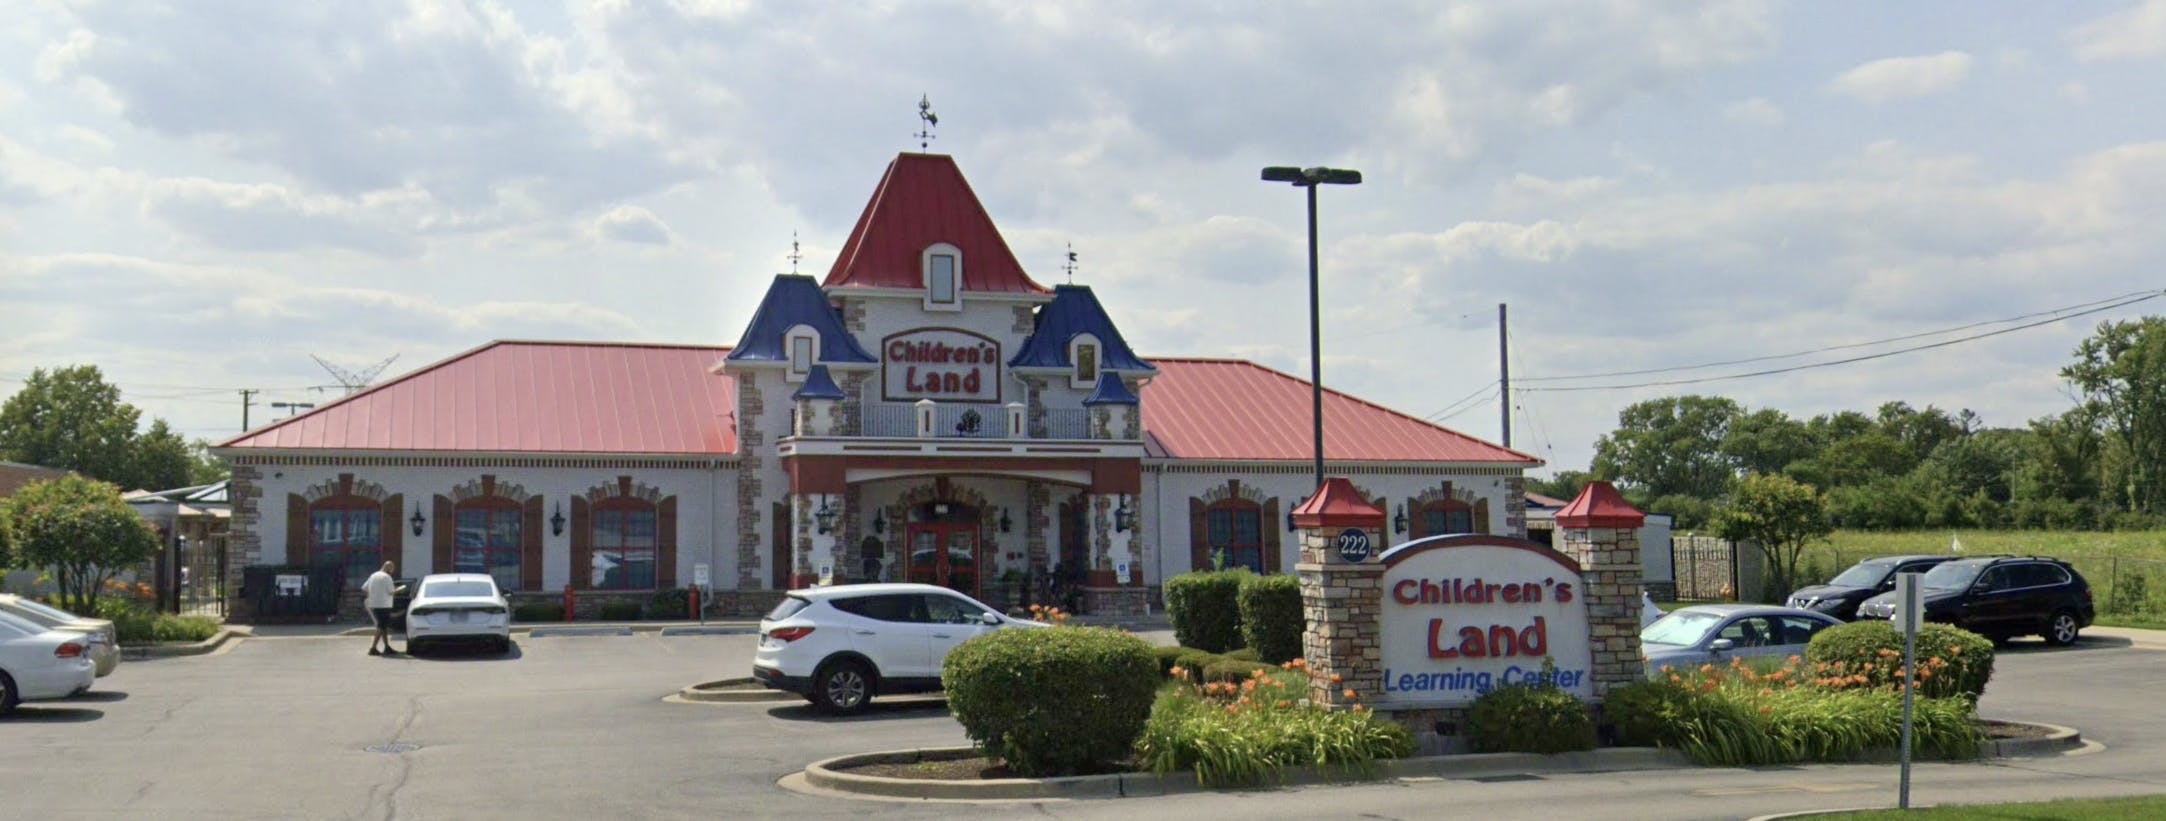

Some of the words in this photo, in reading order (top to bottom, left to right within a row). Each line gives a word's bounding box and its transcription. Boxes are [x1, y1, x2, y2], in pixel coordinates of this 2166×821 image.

[888, 340, 995, 364] Children's
[906, 366, 981, 393] Land
[1340, 535, 1367, 554] 222
[1393, 577, 1573, 605] Children's
[1427, 616, 1547, 659] Land
[1384, 667, 1491, 694] Learning
